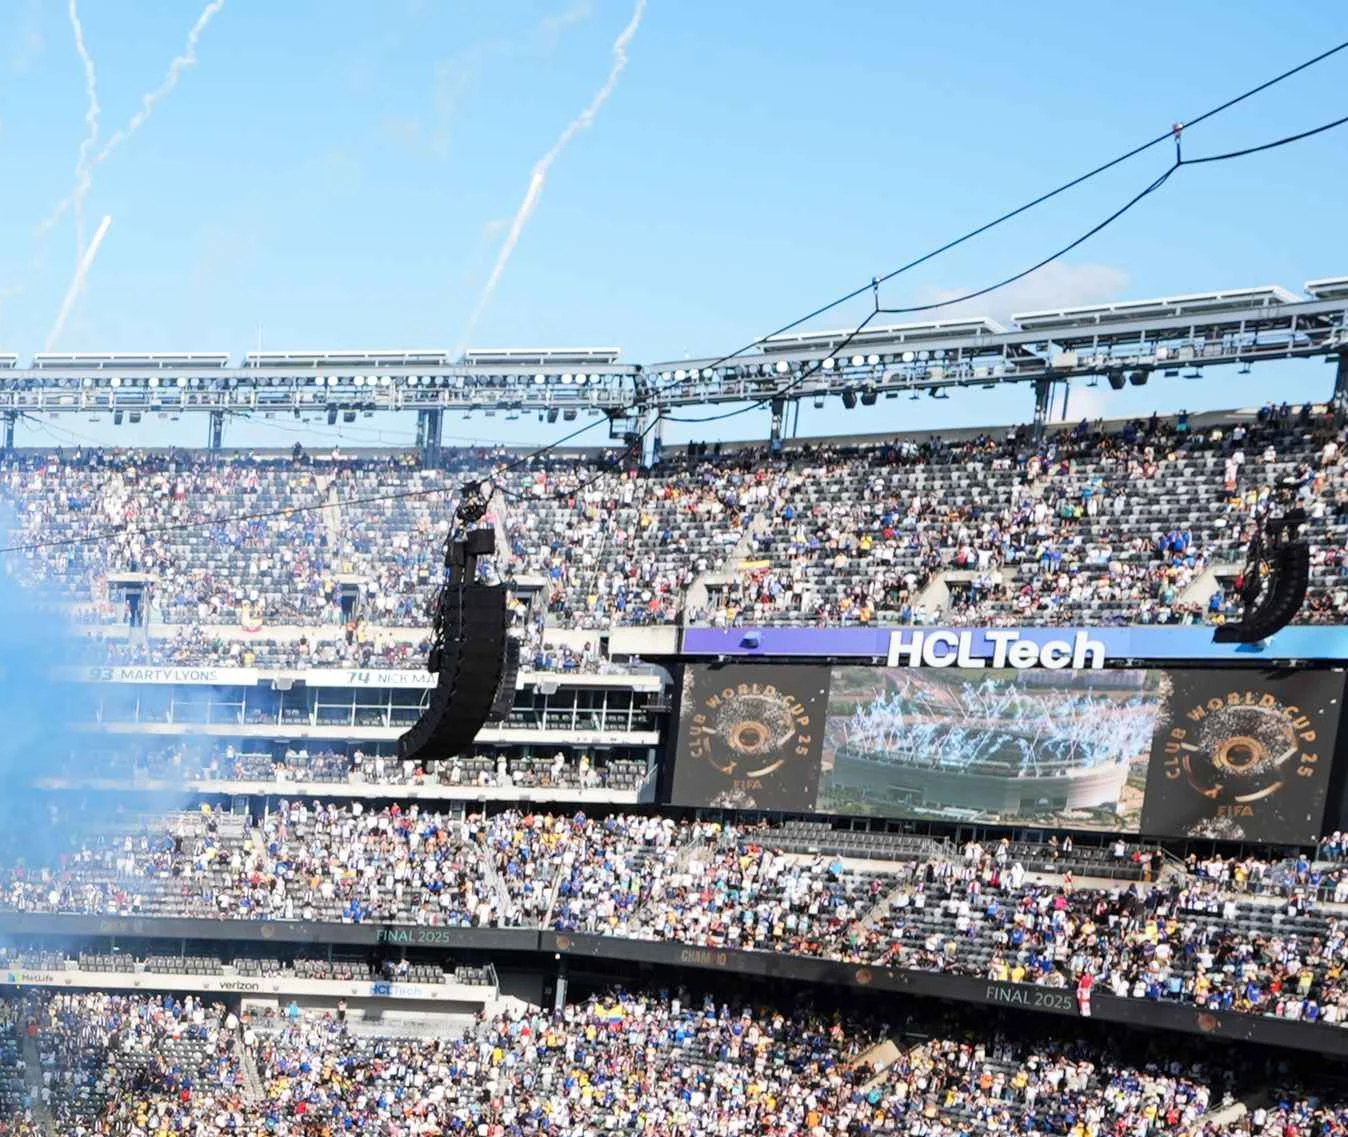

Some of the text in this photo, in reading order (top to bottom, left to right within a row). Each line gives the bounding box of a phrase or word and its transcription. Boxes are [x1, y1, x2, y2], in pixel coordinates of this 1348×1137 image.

[887, 630, 1105, 669] HCLTech
[89, 669, 217, 681] 93 MARTY LYONS
[346, 671, 370, 684] 74
[378, 673, 409, 683] NICK
[688, 714, 706, 758] CLUB
[705, 683, 776, 708] WORLD
[782, 695, 809, 726] CUP
[1164, 727, 1187, 779] CLUB
[1186, 691, 1276, 721] WORLD
[1283, 706, 1317, 742] CUP
[1217, 805, 1254, 816] FIFA
[376, 929, 449, 943] FINAL 2025
[22, 973, 54, 982] MetLife
[219, 979, 259, 990] verizon
[986, 985, 1073, 1009] FINAL 2025
